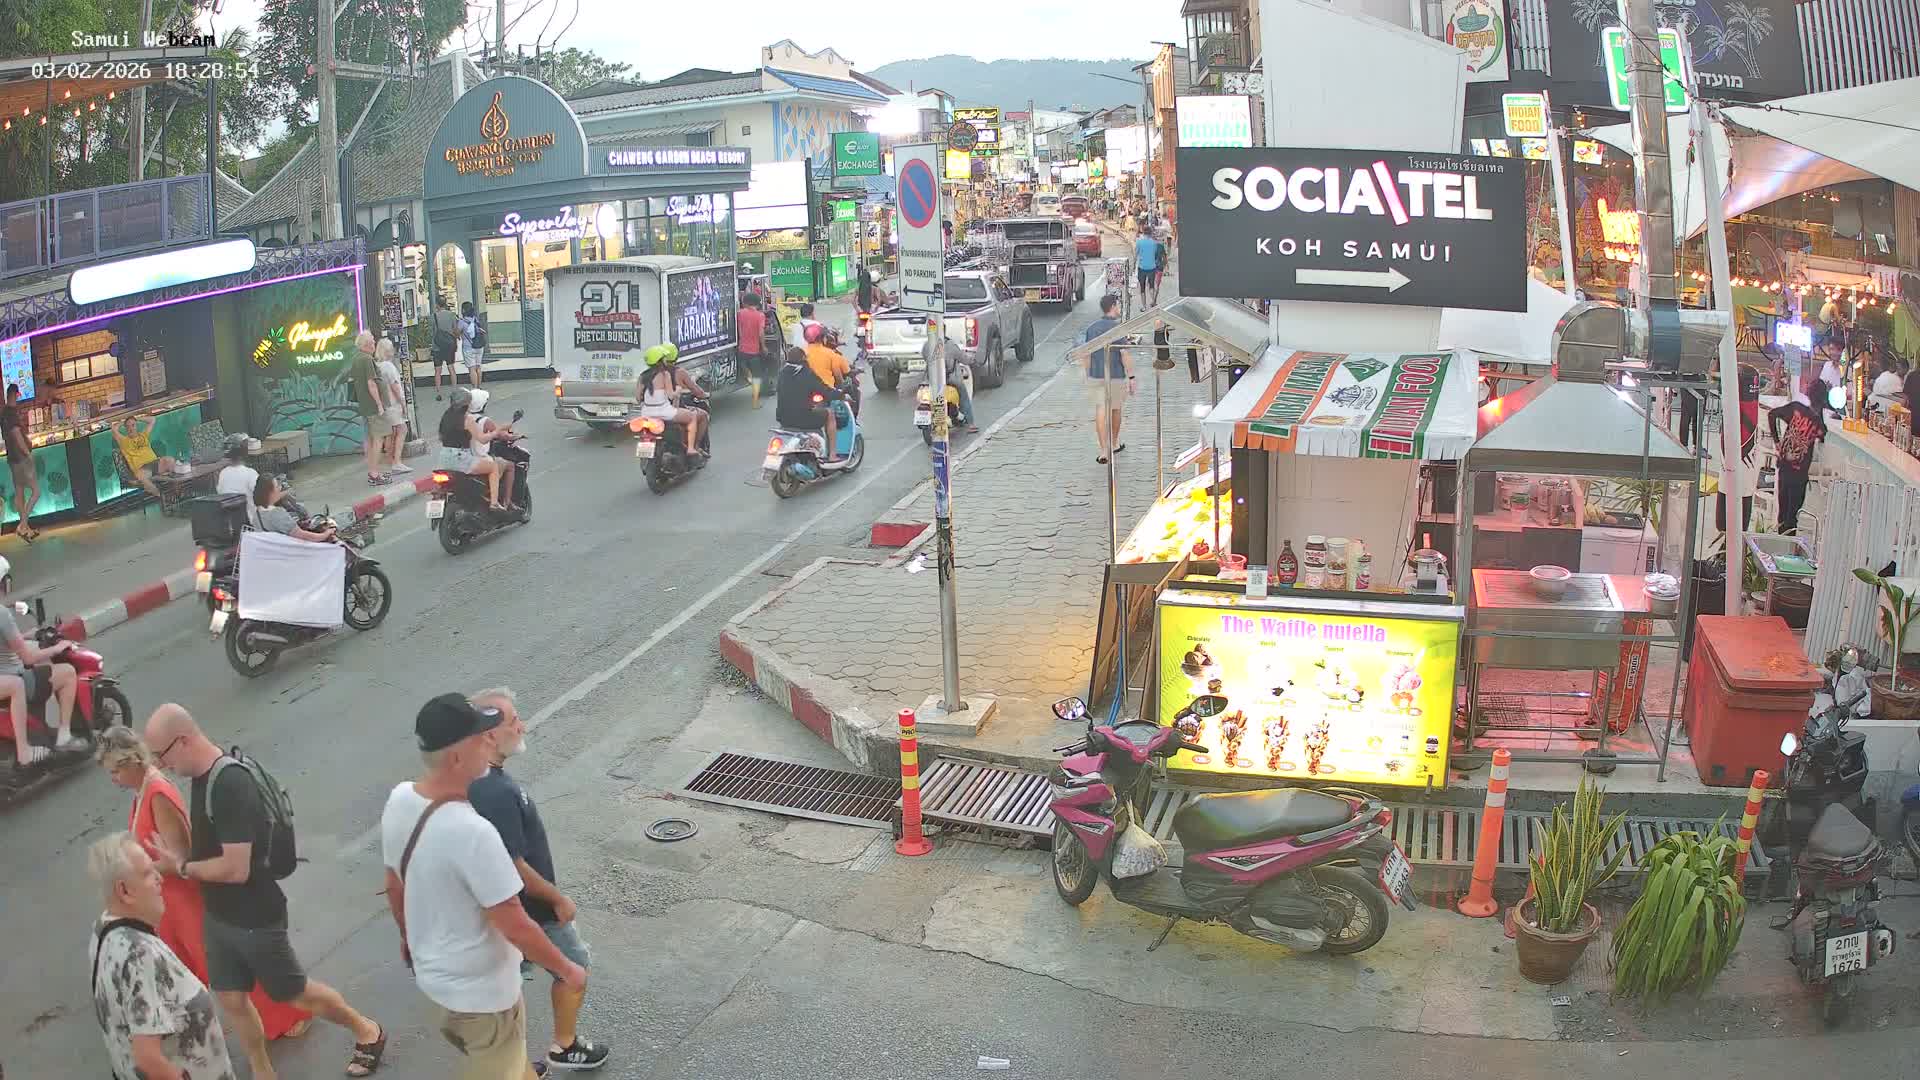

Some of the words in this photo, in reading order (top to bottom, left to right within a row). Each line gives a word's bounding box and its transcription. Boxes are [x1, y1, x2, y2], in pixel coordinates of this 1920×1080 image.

[1508, 106, 1541, 118] INDIAN
[1511, 119, 1540, 132] FOOD
[503, 131, 556, 152] GARDEN
[608, 149, 654, 165] CHAWENG
[838, 160, 878, 170] EXCHANGE
[1256, 238, 1321, 256] KOH
[1342, 240, 1451, 262] SAMUI
[772, 266, 811, 276] EXCHANGE
[904, 269, 912, 277] NO
[913, 269, 937, 279] PARKING
[677, 311, 717, 343] KARAOKE
[576, 331, 605, 344] PHETCH
[608, 331, 639, 344] BUNCHA
[296, 351, 343, 365] THAILAND
[1392, 357, 1442, 394] FOOD
[1368, 396, 1430, 456] INDIAN
[1221, 615, 1254, 634] The
[1260, 617, 1317, 639] Waffle
[1323, 623, 1386, 642] nutella
[1832, 958, 1861, 975] 1676
